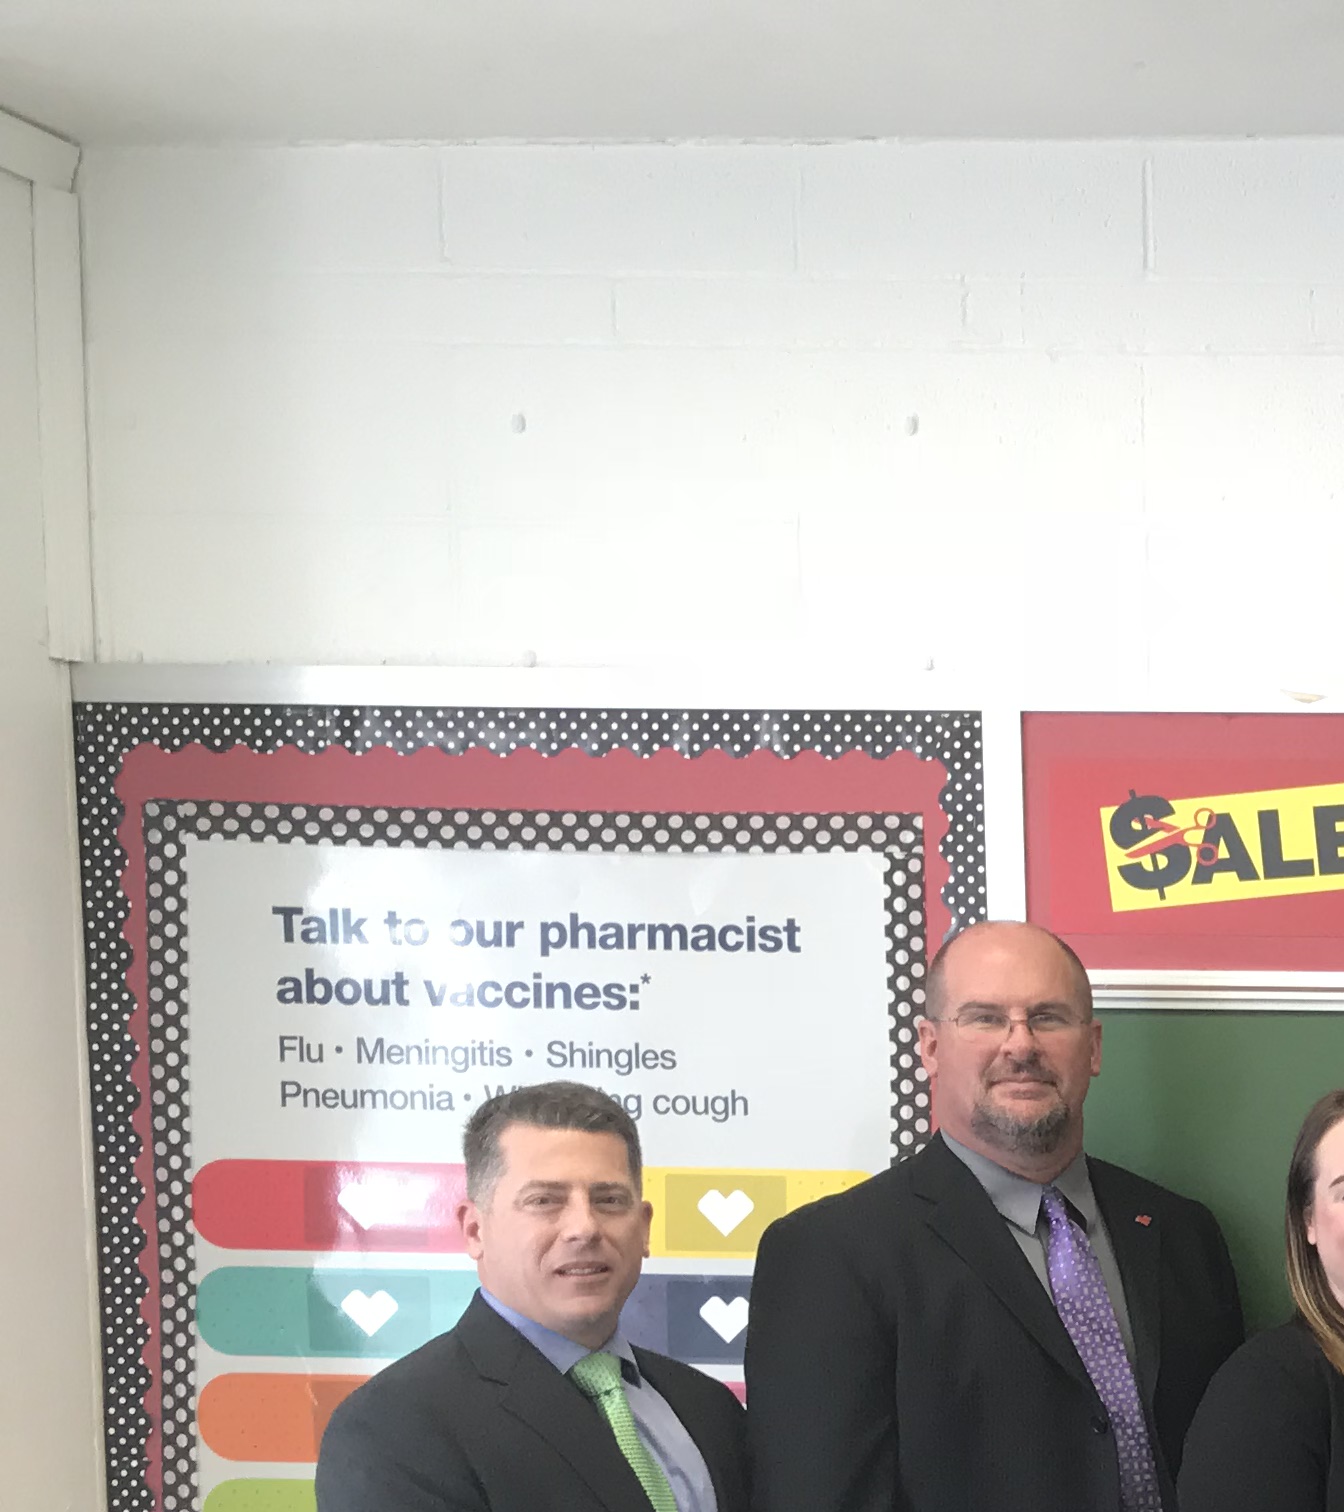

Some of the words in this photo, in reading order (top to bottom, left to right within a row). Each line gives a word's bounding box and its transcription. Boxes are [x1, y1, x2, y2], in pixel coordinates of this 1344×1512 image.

[272, 906, 369, 947] Talk
[384, 911, 429, 947] to
[449, 916, 524, 949] our
[539, 912, 802, 957] pharmacist
[276, 968, 410, 1007] about
[279, 1036, 325, 1064] Flu
[356, 1037, 513, 1073] Meningitis
[546, 1040, 677, 1076] Shingles
[280, 1080, 455, 1111] Pneumonia
[652, 1090, 749, 1123] cough
